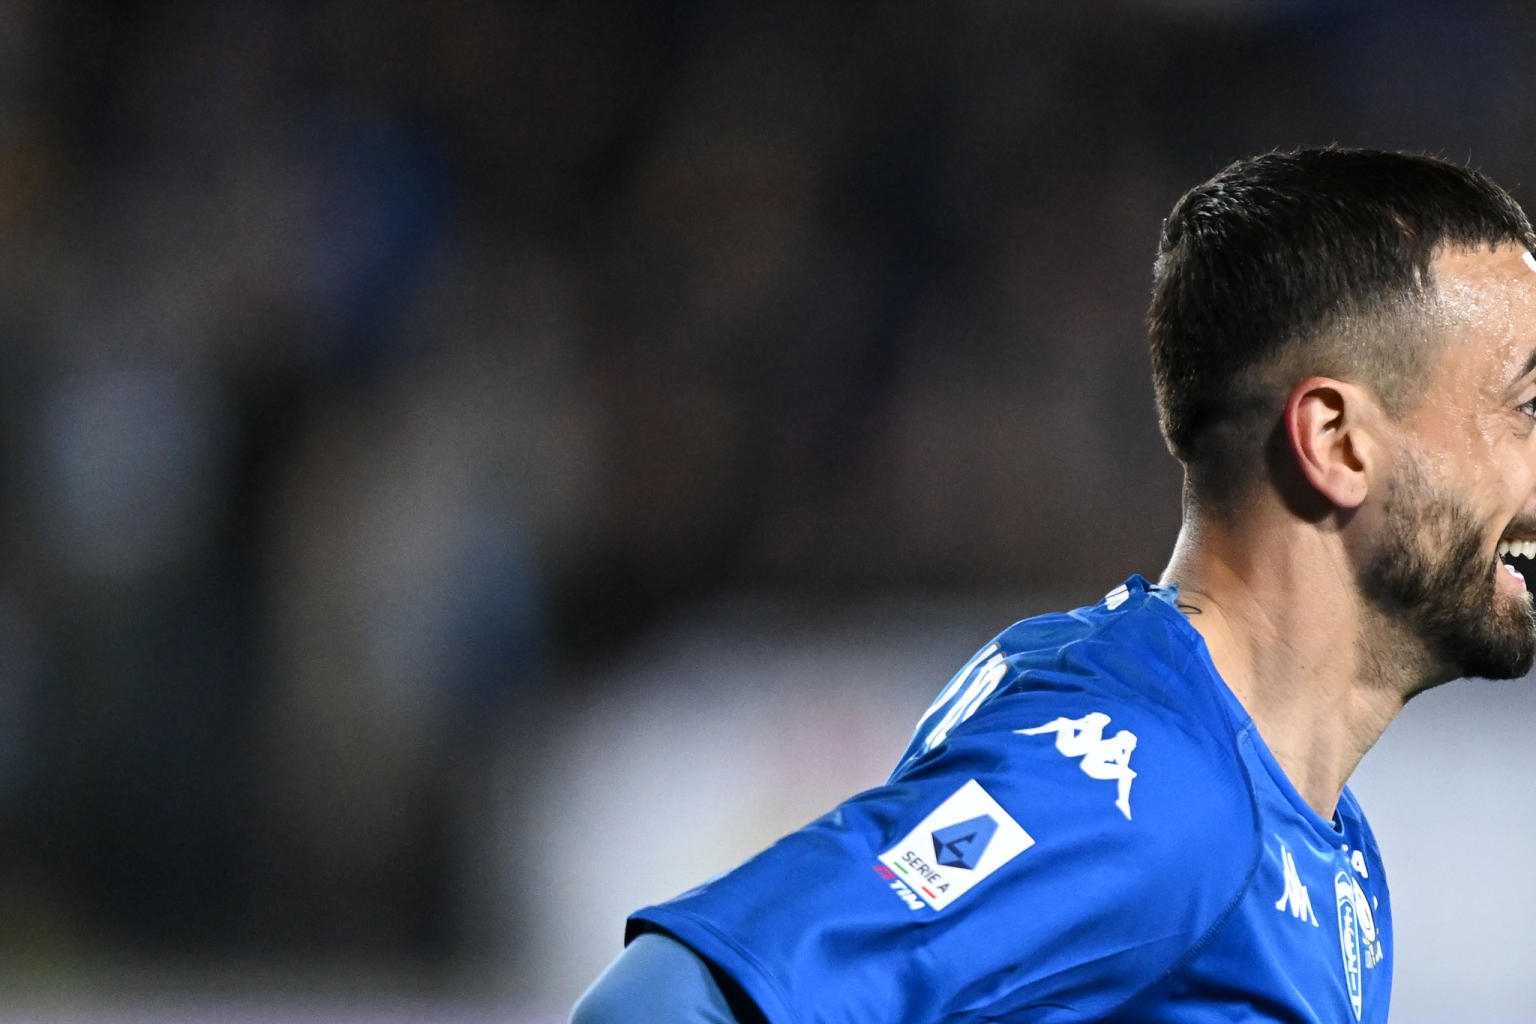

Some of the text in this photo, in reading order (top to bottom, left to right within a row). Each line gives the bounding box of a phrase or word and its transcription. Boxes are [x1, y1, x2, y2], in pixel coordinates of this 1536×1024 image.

[901, 850, 951, 894] SERIE A
[890, 879, 926, 911] TIM
